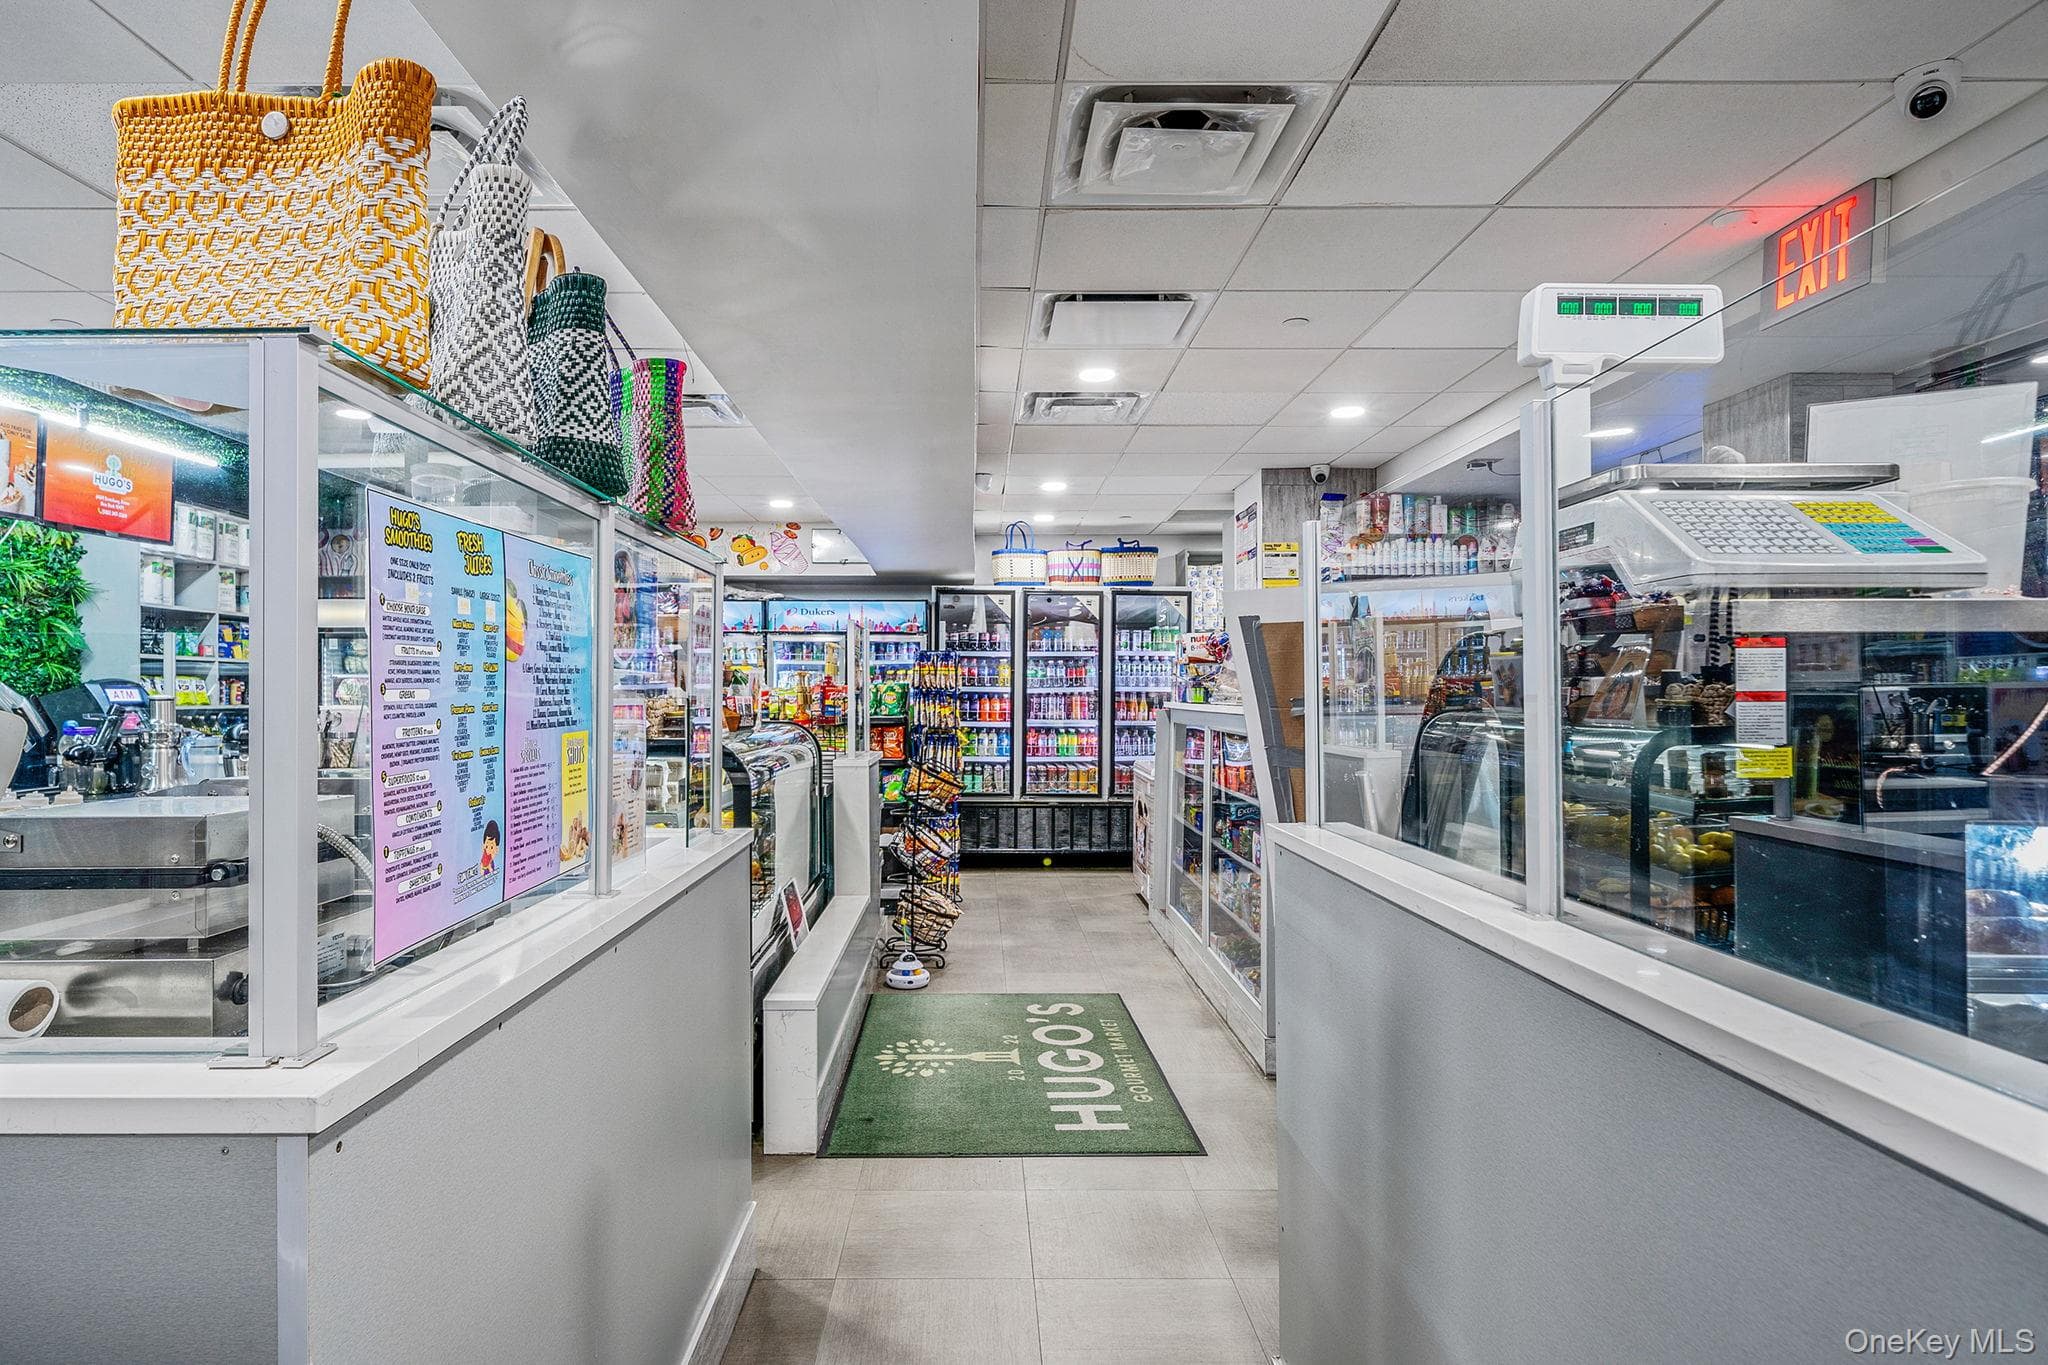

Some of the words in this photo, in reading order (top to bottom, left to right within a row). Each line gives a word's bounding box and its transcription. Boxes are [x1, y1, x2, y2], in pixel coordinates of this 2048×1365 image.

[1775, 195, 1858, 312] EXIT
[94, 472, 132, 491] HUGO'S
[390, 506, 421, 531] HUGO'S
[384, 526, 434, 553] SMOOTHIES
[456, 530, 484, 554] FRESH
[464, 554, 494, 576] JUICES
[528, 558, 548, 581] Classic
[388, 568, 412, 583] INCLUDES
[416, 574, 434, 586] FRUITS
[386, 602, 404, 613] CHOOSE
[800, 608, 836, 616] Dukers
[113, 690, 135, 699] ATM
[398, 690, 416, 700] GREENS
[566, 745, 585, 766] SHOTS
[388, 774, 416, 786] SUPERFOODS
[394, 846, 416, 860] TOPPINGS
[1002, 1034, 1020, 1046] 22
[1100, 1018, 1130, 1051] MARKET
[1007, 1068, 1026, 1082] 20
[1026, 1002, 1131, 1132] HUGO'S
[1114, 1054, 1154, 1104] GOURMET
